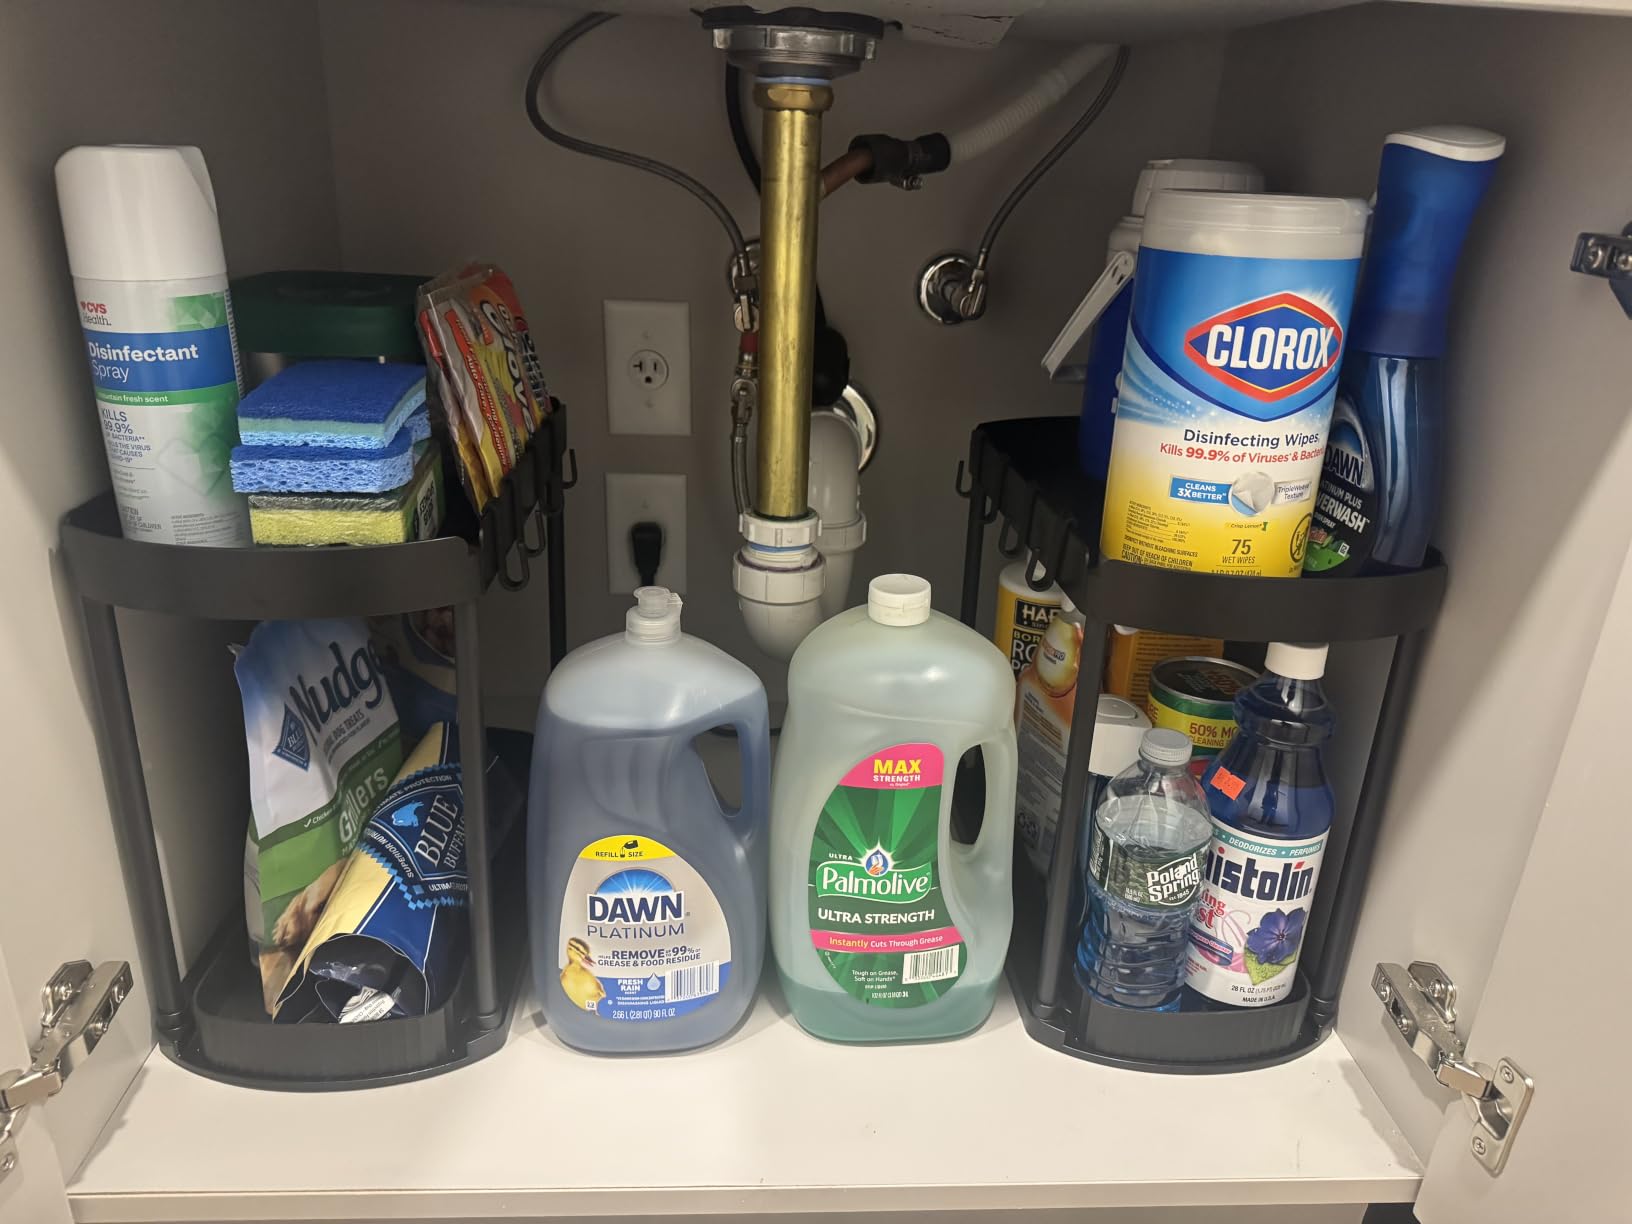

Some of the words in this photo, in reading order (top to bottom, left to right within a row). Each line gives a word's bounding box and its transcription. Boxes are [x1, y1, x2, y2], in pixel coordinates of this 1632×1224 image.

[87, 301, 107, 314] CVS
[88, 341, 199, 362] Disinfectant
[1206, 324, 1335, 370] CLOROX
[91, 359, 130, 382] Spray
[466, 355, 478, 381] Auto
[123, 394, 144, 403] fresh
[145, 395, 169, 403] scent
[101, 408, 127, 422] KILLS
[103, 419, 133, 435] 99.9%
[1183, 429, 1280, 449] Disinfecting
[1160, 443, 1183, 457] Kills
[1185, 446, 1229, 462] 99.9%
[1232, 453, 1245, 463] of
[1292, 451, 1298, 462] &
[1177, 488, 1192, 498] 3X
[1185, 482, 1217, 492] CLEANS
[1344, 492, 1363, 509] PLUS
[1231, 539, 1252, 555] 75
[1167, 555, 1193, 567] CHILDREN
[1222, 556, 1236, 564] WET
[1237, 556, 1256, 564] WIPES
[1189, 722, 1217, 738] 50%
[873, 759, 922, 775] MAX
[403, 775, 453, 791] PROTECTION
[873, 774, 921, 783] STRENGTH
[414, 794, 459, 868] BLUE
[595, 850, 619, 858] REFILL
[1228, 836, 1278, 856] DEODORIZES
[385, 843, 415, 879] SUPERIOR
[828, 853, 853, 861] ULTRA
[1146, 852, 1199, 886] Poland
[822, 866, 930, 895] Palmolive
[1147, 869, 1200, 902] Spring
[588, 893, 683, 922] DAWN
[818, 908, 862, 924] ULTRA
[865, 909, 935, 925] STRENGTH
[587, 923, 684, 940] PLATINUM
[829, 937, 869, 949] Instantly
[870, 940, 887, 948] Cuts
[889, 938, 918, 949] Through
[919, 935, 943, 945] Grease
[598, 959, 632, 967] GREASE
[641, 959, 665, 967] FOOD
[666, 953, 701, 965] RESIDUE
[612, 948, 665, 960] REMOVE
[852, 969, 869, 977] Tough
[620, 984, 641, 992] RAIN
[653, 1009, 662, 1018] 90
[662, 1008, 669, 1017] FL
[669, 1007, 676, 1017] OZ
